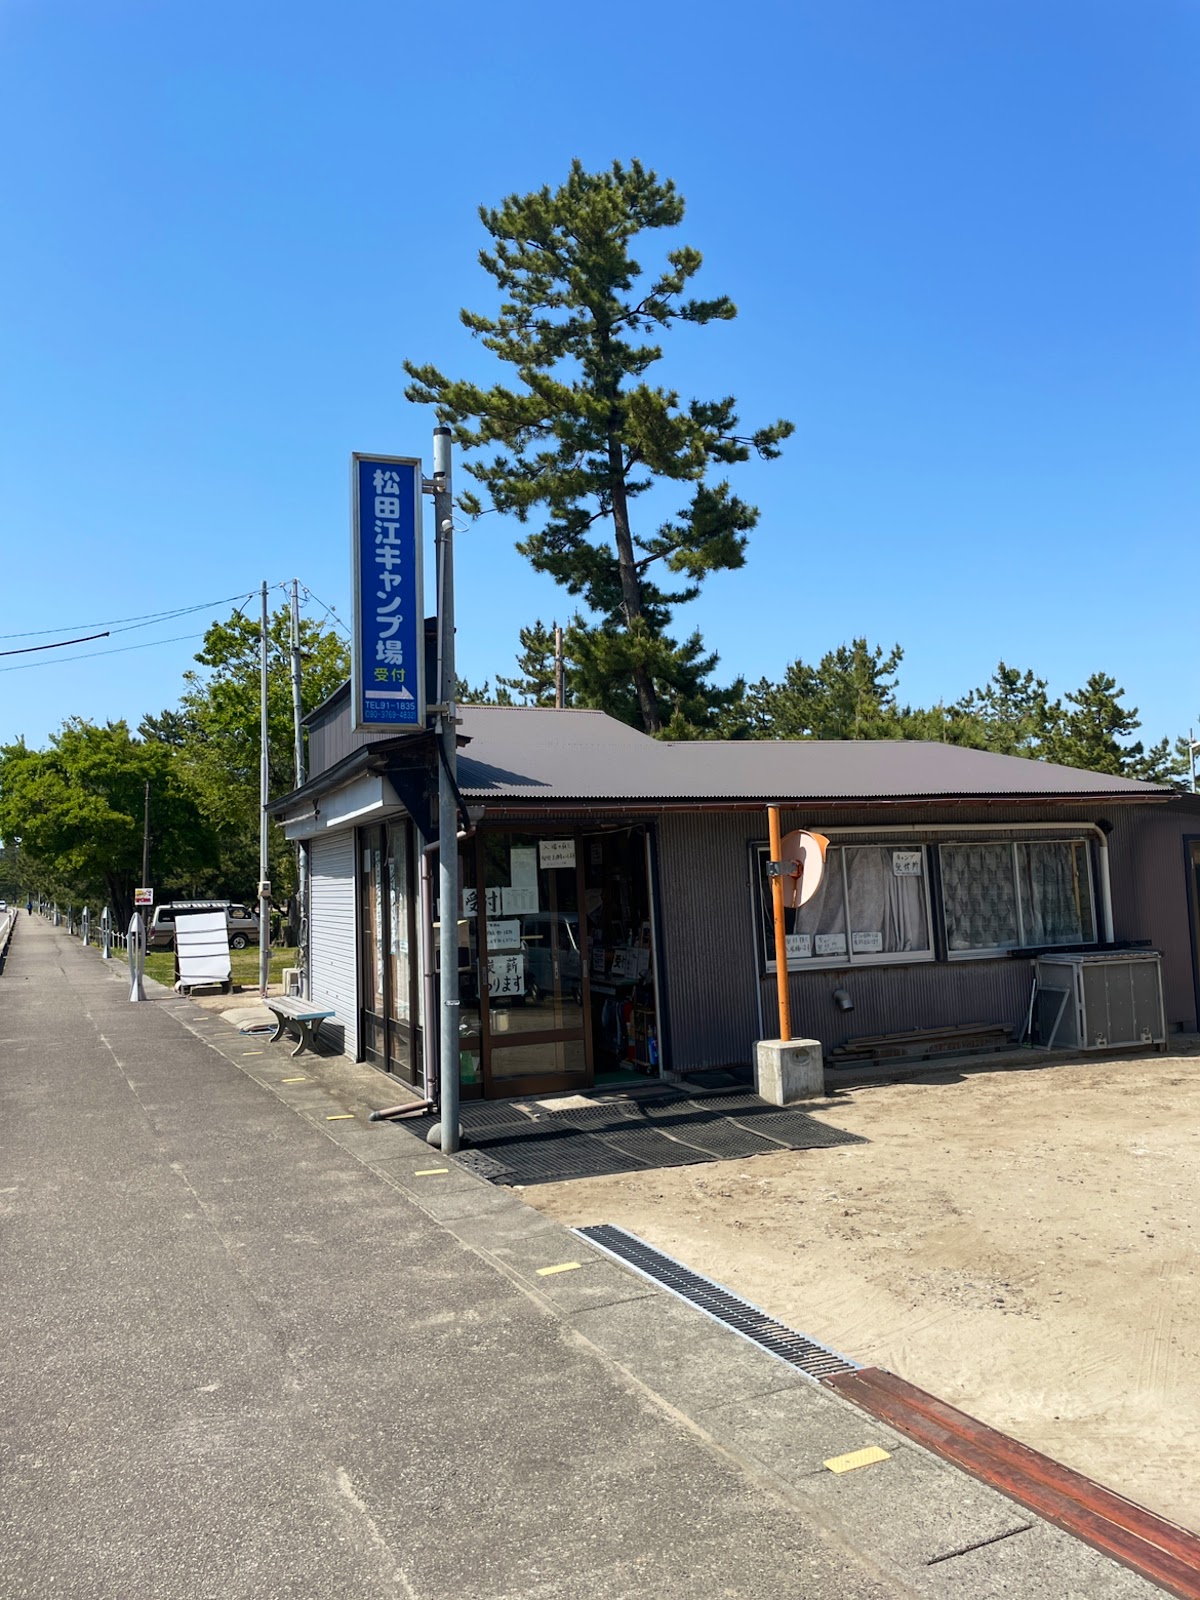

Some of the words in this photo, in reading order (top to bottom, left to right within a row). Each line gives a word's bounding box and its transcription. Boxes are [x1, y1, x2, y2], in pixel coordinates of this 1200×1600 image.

[372, 469, 404, 665] 松田江キャンプ場
[373, 667, 406, 683] 受付
